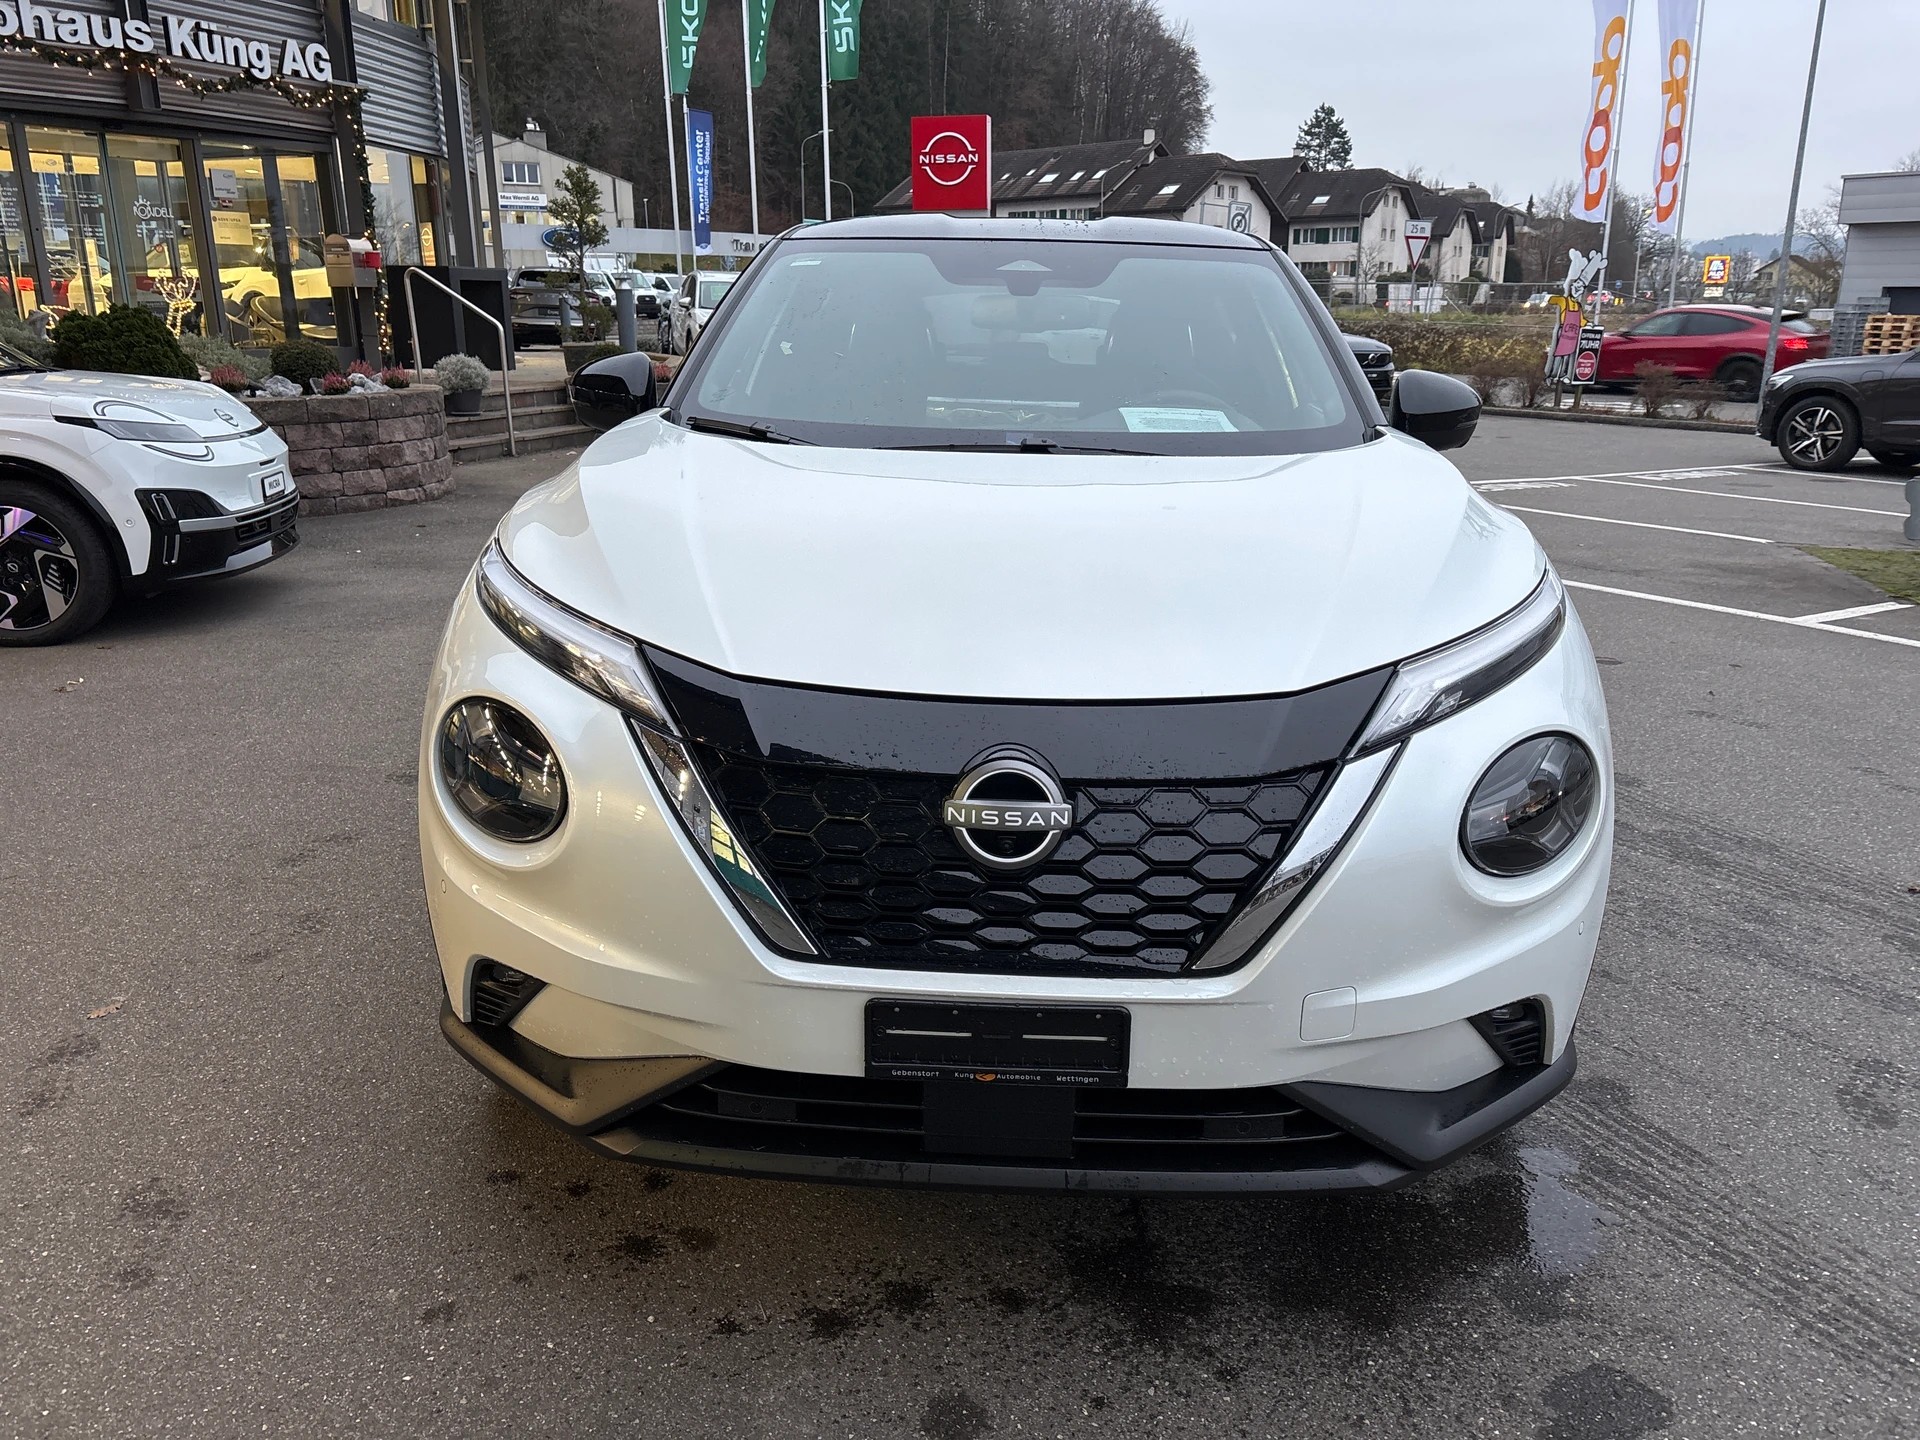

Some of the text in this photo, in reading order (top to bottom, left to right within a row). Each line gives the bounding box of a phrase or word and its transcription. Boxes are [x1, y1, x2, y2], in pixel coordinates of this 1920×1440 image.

[165, 15, 272, 80] Küng
[281, 38, 333, 82] AG
[1584, 16, 1626, 211] coop
[1655, 38, 1691, 223] coop
[695, 129, 706, 224] Transit Center
[919, 153, 979, 164] NISSAN
[1411, 224, 1419, 233] 25
[946, 806, 1070, 827] NISSAN
[996, 1073, 1041, 1081] Automobile
[1056, 1075, 1100, 1084] Wettingen
